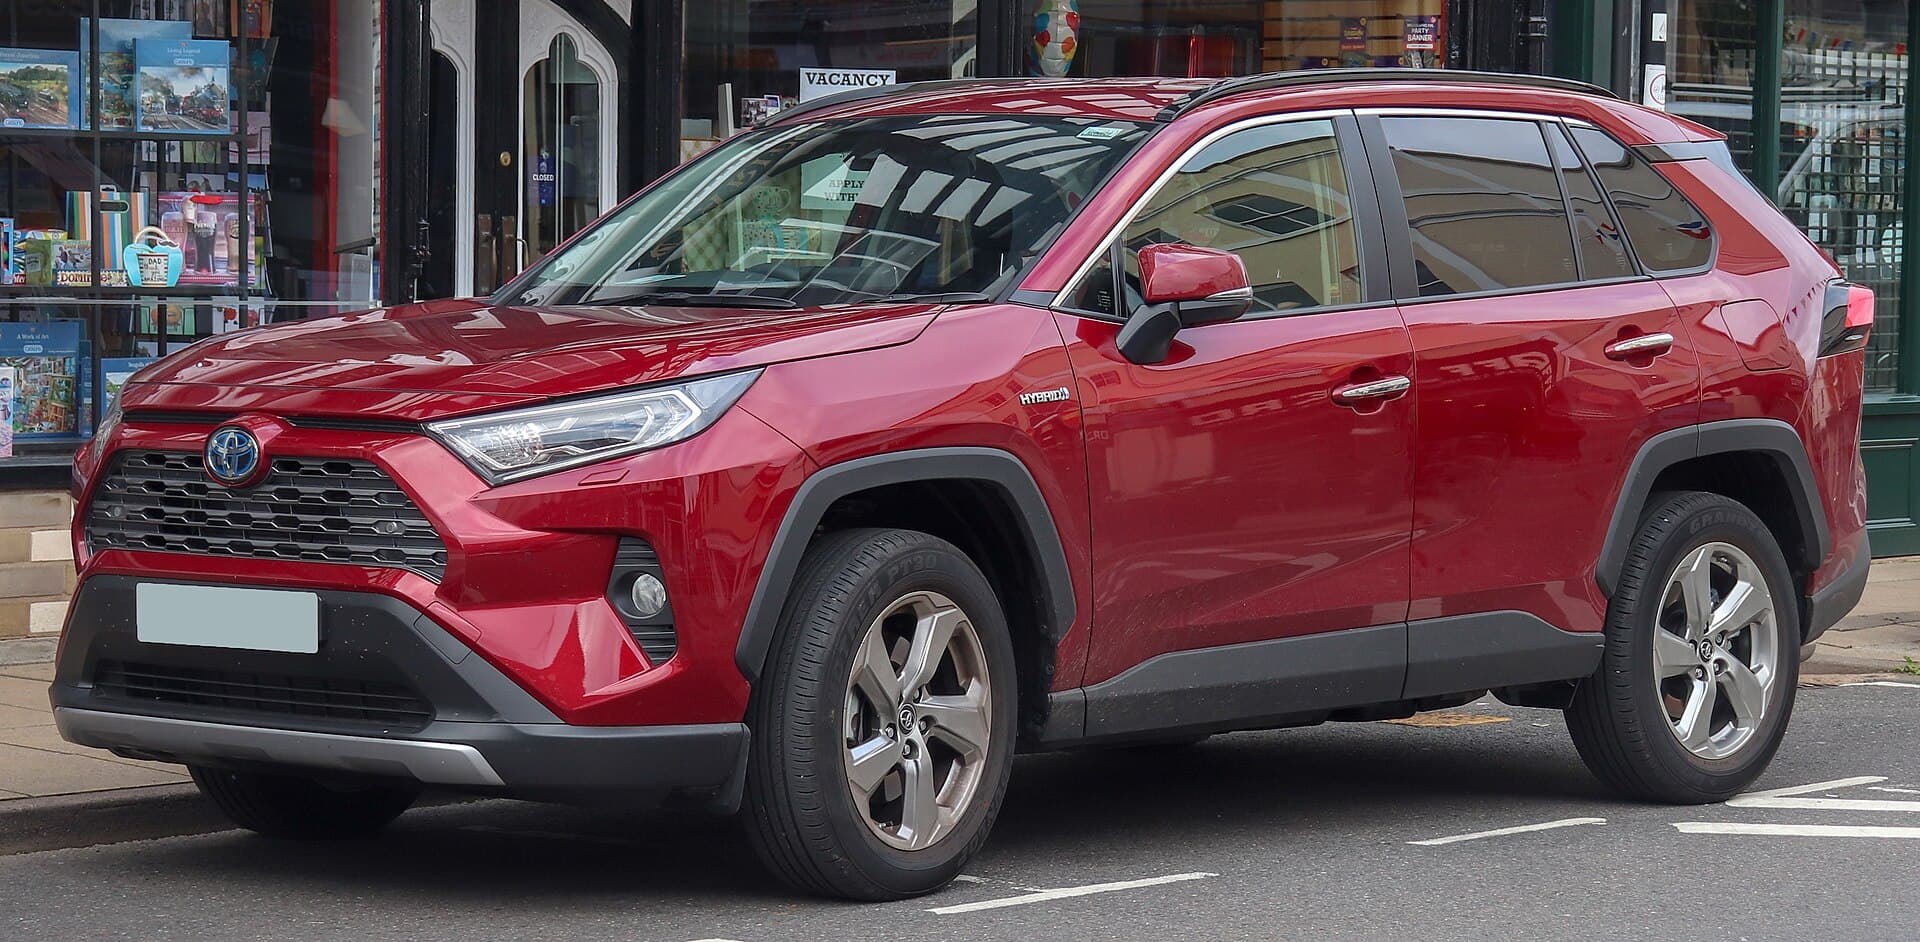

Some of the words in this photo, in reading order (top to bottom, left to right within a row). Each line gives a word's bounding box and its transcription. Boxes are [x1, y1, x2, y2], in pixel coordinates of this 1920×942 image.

[1407, 34, 1433, 42] BANNER
[805, 72, 891, 87] VACANCY
[532, 173, 555, 182] CLOSED
[829, 180, 865, 189] APPLY
[825, 192, 858, 202] WITH
[148, 258, 162, 266] DAD
[1019, 388, 1062, 405] HYBRID
